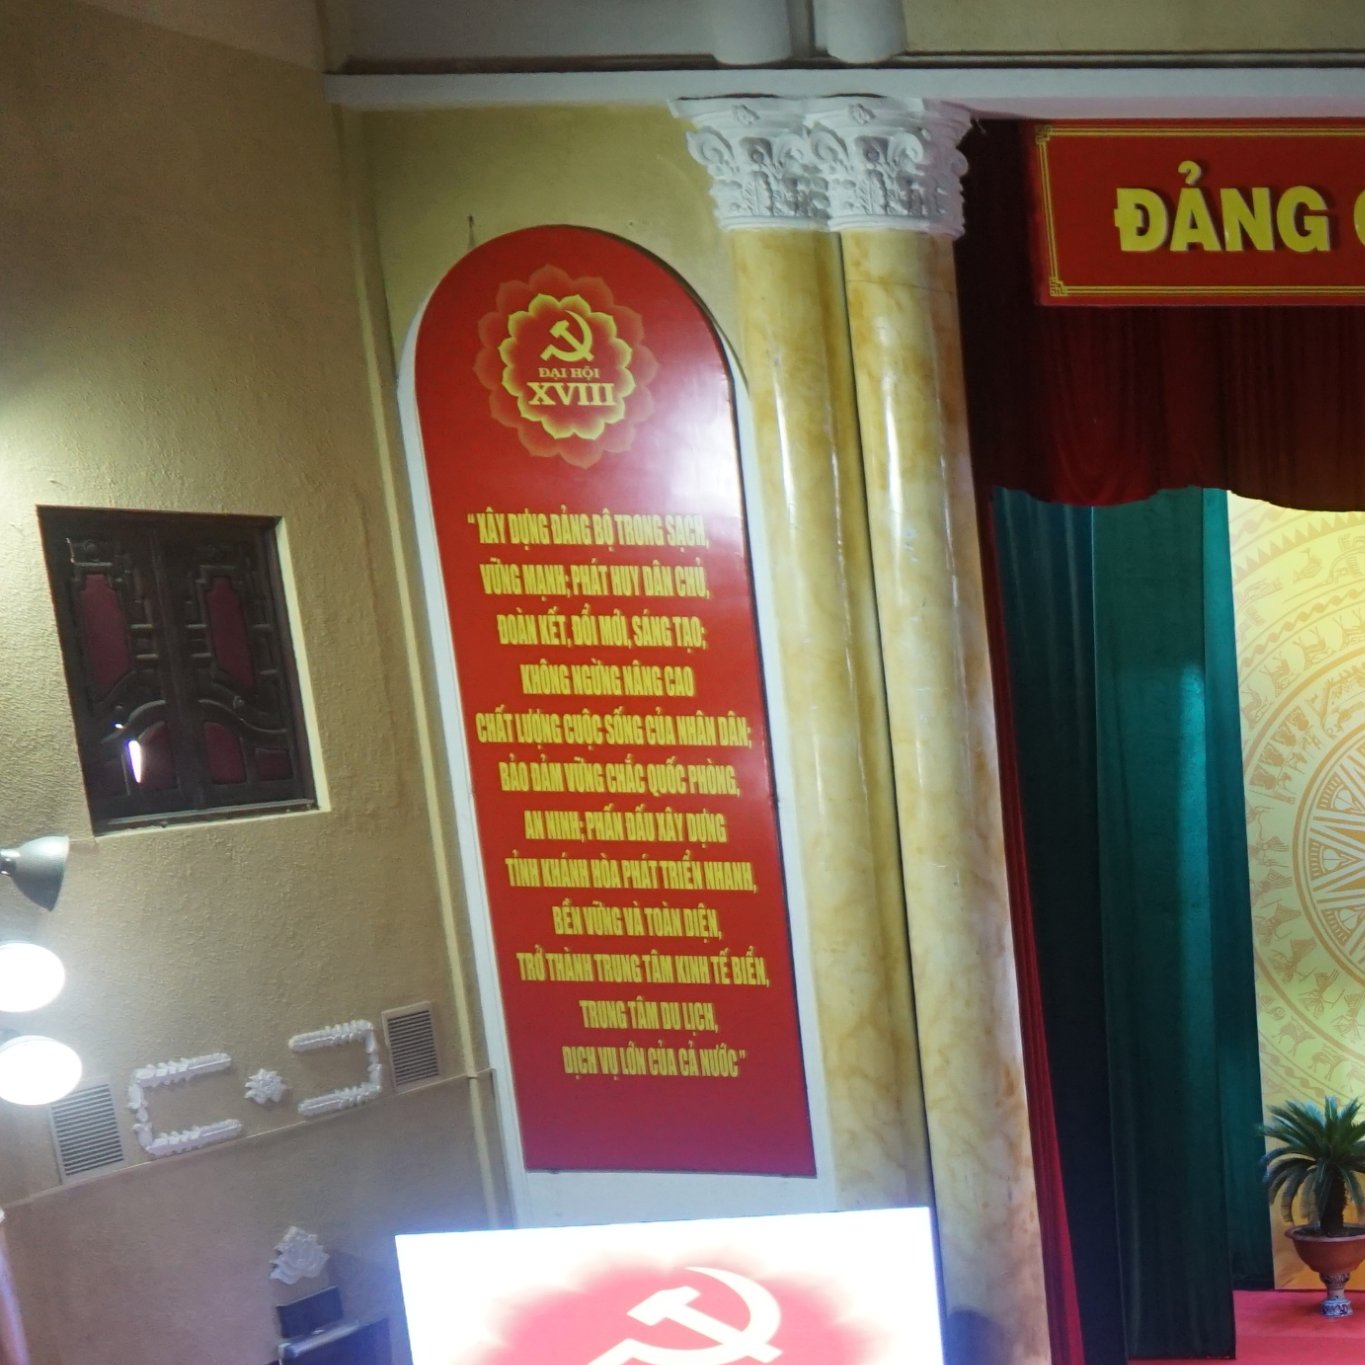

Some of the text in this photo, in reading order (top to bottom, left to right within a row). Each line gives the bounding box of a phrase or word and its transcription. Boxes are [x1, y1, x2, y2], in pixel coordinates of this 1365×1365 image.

[1114, 160, 1329, 252] ĐẢNG
[538, 366, 600, 380] ĐẠI HỘI
[527, 382, 616, 405] XVIII
[507, 508, 549, 550] DỰNG
[550, 504, 592, 545] ĐẢNG
[592, 508, 614, 551] BỘ
[614, 513, 664, 545] TRONG
[665, 513, 709, 552] SẠCH,
[520, 658, 695, 697] KHÔNG NGỪNG NÂNG CAO
[475, 704, 514, 742] CHẤT
[514, 708, 562, 749] LƯỢNG
[563, 708, 603, 750] CUỘC
[604, 706, 644, 744] SỐNG
[645, 707, 676, 744] CỦA
[676, 710, 716, 745] NHÂN
[505, 849, 540, 886] TỈNH
[540, 852, 590, 887] KHÁNH
[590, 852, 621, 888] HÒA
[621, 853, 658, 889] PHÁT
[659, 849, 703, 889] TRIỂN
[579, 995, 718, 1036] TRUNG TÂM DU LỊCH,
[562, 1046, 598, 1080] DỊCH
[598, 1047, 619, 1080] VỤ
[619, 1040, 646, 1075] LỚN
[648, 1040, 678, 1076] CỦA
[678, 1040, 699, 1076] CẢ
